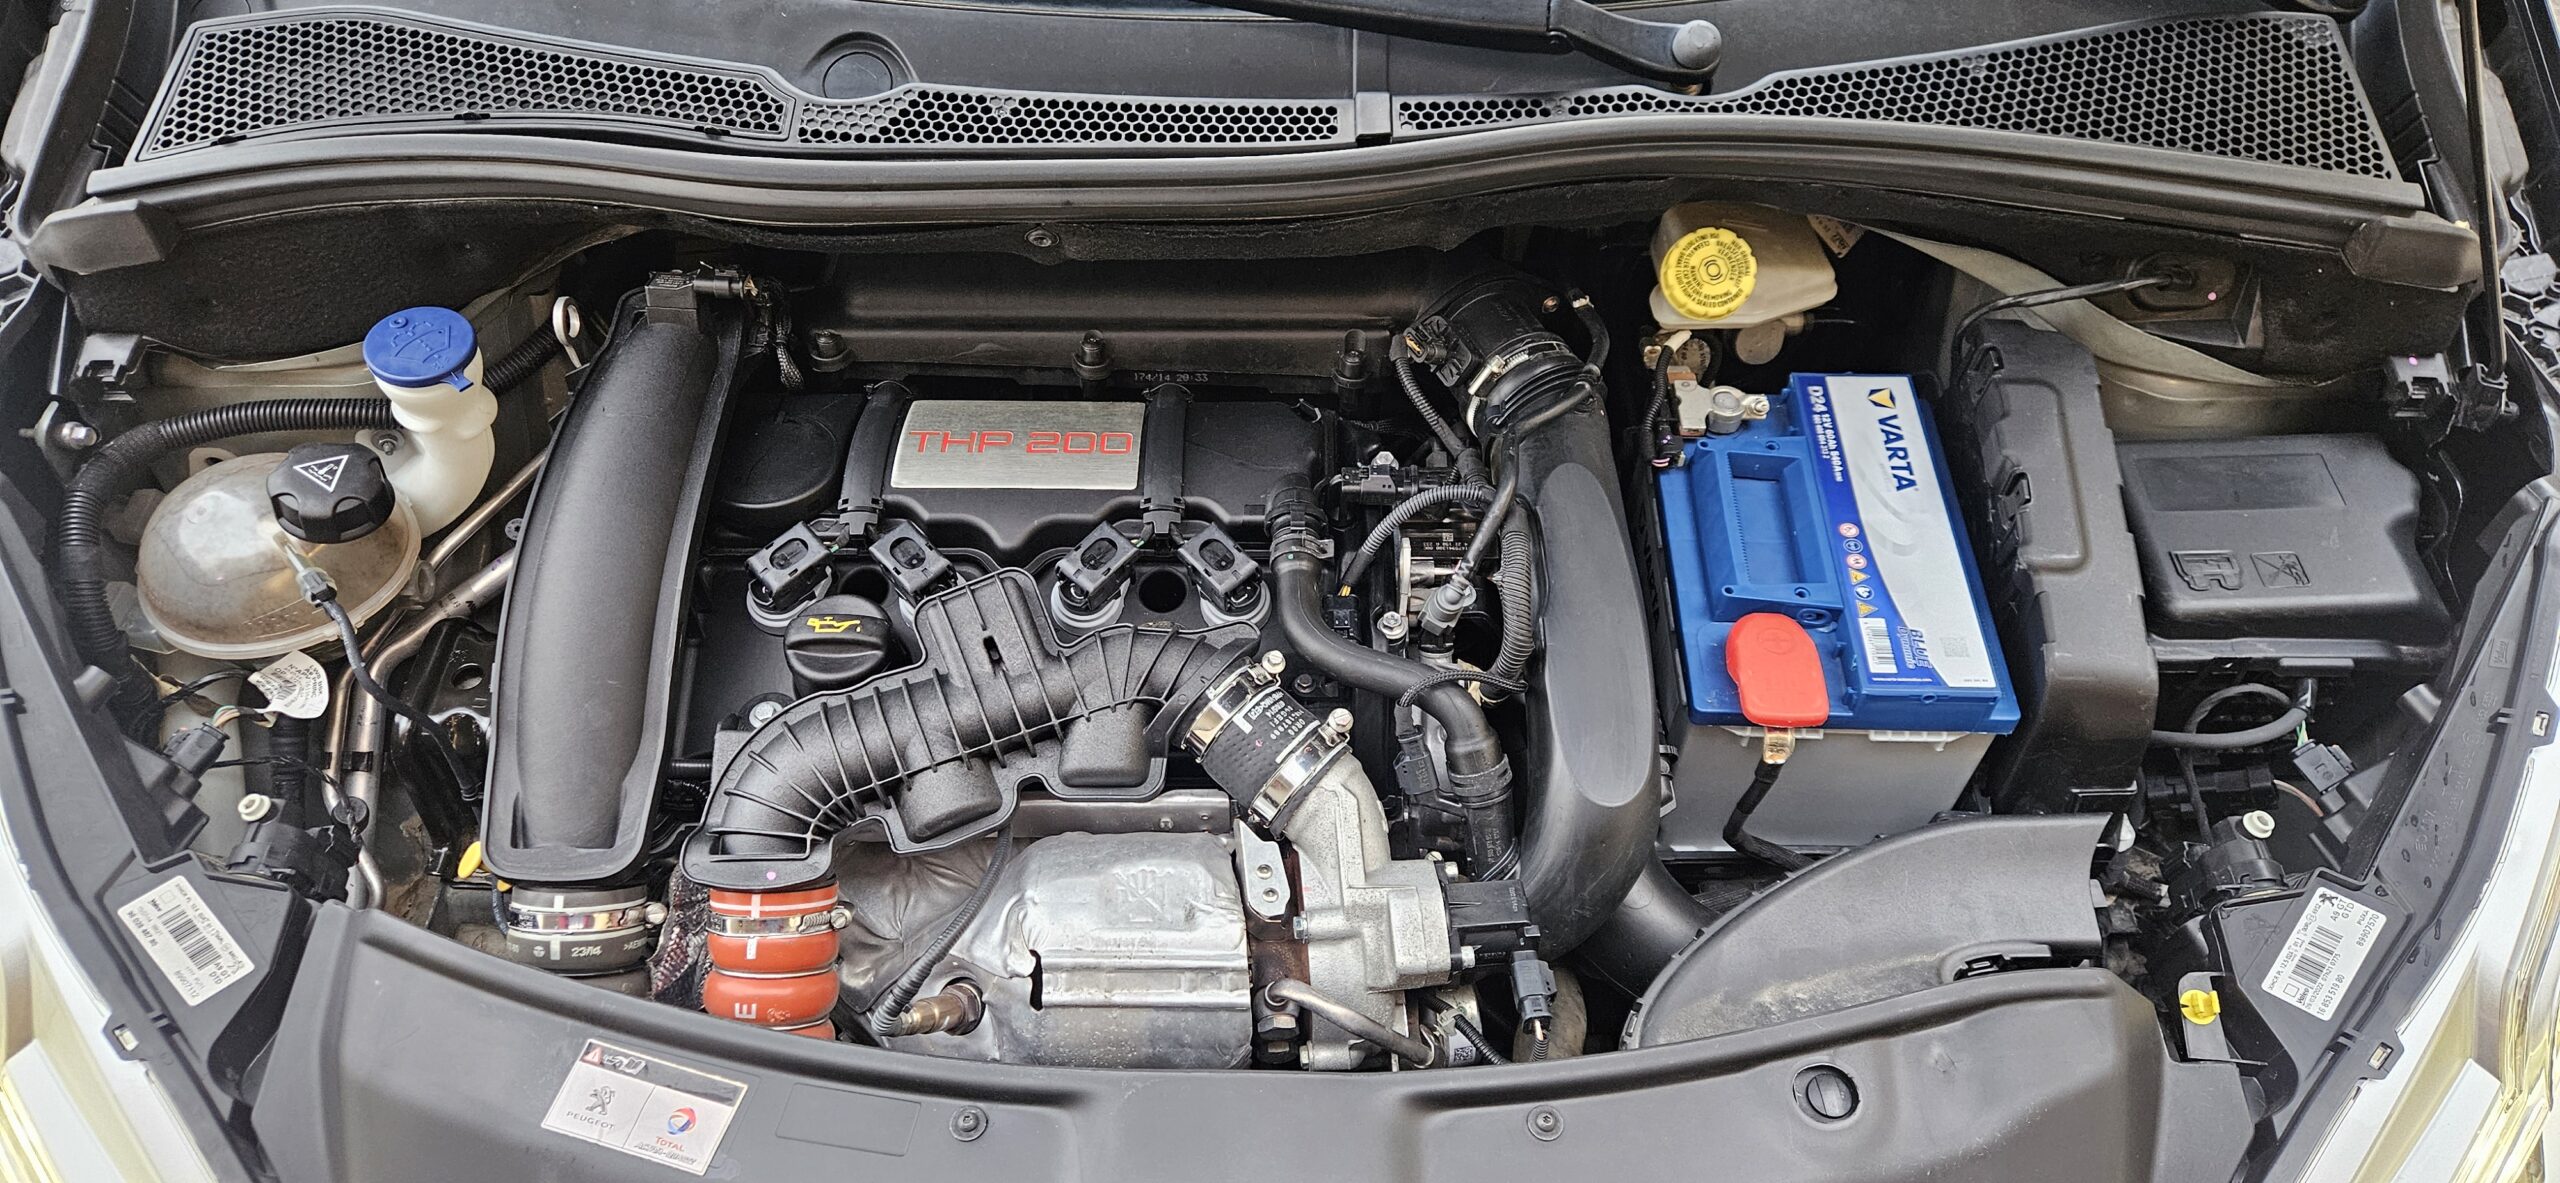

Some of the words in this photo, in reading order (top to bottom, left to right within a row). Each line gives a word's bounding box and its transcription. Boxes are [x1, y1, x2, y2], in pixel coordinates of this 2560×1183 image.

[1692, 240, 1709, 252] CLEAN
[1683, 249, 1695, 268] FILLER
[1690, 265, 1703, 289] WARNING
[1675, 270, 1683, 285] FLUID
[1679, 284, 1692, 299] FROM
[1696, 298, 1715, 307] SEALED
[1717, 287, 1743, 307] CONTAINER
[1685, 280, 1702, 297] BEFORE
[1703, 289, 1732, 300] REMOVING
[1807, 383, 1827, 413] D24
[1820, 413, 1832, 428] 12V
[909, 430, 1015, 454] THP
[1025, 430, 1134, 454] 200
[1824, 428, 1837, 450] 60Ah
[1878, 414, 1915, 492] VARTA
[1908, 627, 1931, 670] BLUE
[2330, 910, 2339, 920] A9
[2336, 898, 2346, 910] GT
[2342, 902, 2354, 918] GTD
[2297, 988, 2311, 1003] Valeo
[2316, 1007, 2325, 1015] 16
[2321, 994, 2332, 1007] 853
[2328, 982, 2339, 994] 519
[2335, 973, 2344, 982] 80
[566, 1111, 615, 1130] PEUGEOT
[655, 1136, 685, 1152] TOTAL
